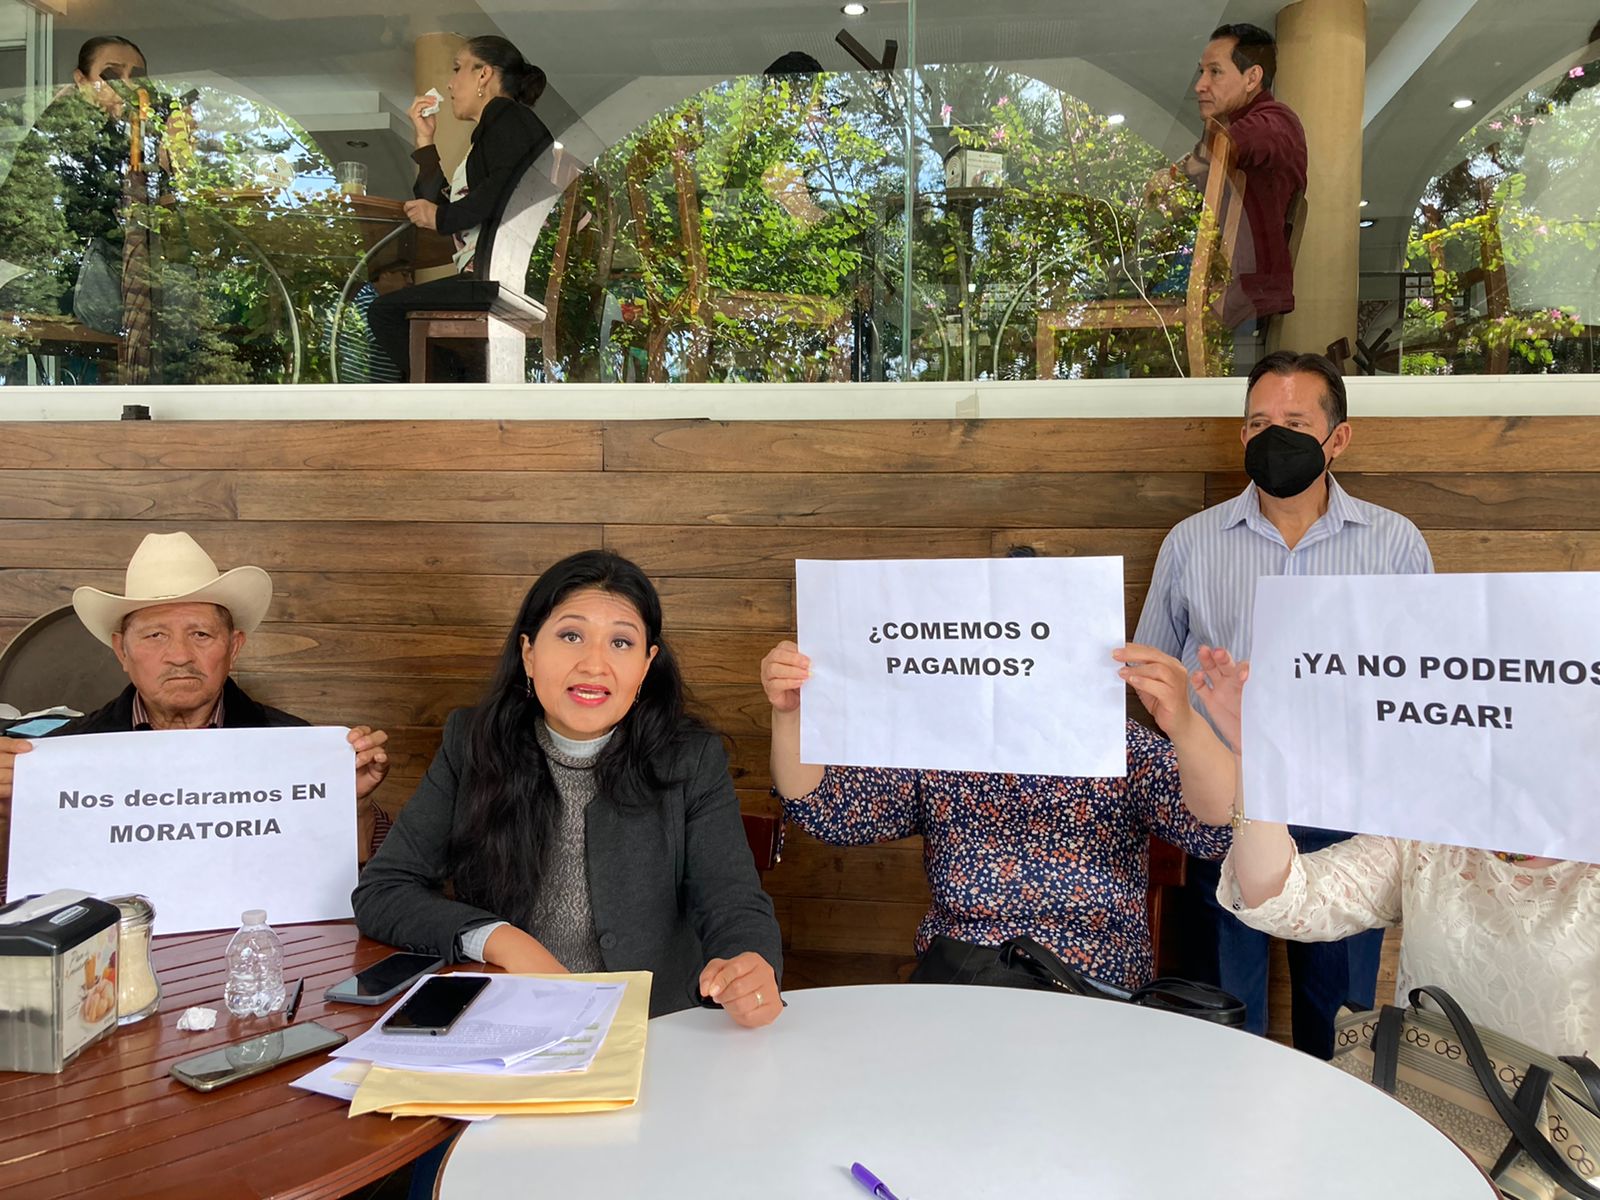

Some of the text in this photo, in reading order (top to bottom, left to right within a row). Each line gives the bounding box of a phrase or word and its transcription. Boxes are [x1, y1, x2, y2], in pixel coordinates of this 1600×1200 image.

[868, 622, 1050, 644] ¿COMEMOS O
[886, 657, 1035, 677] PAGAMOS?
[1294, 653, 1347, 679] ¡YA
[1357, 655, 1407, 678] NO
[1376, 700, 1513, 730] PAGAR!
[59, 782, 326, 809] Nos declaramos EN
[110, 819, 282, 844] MORATORIA
